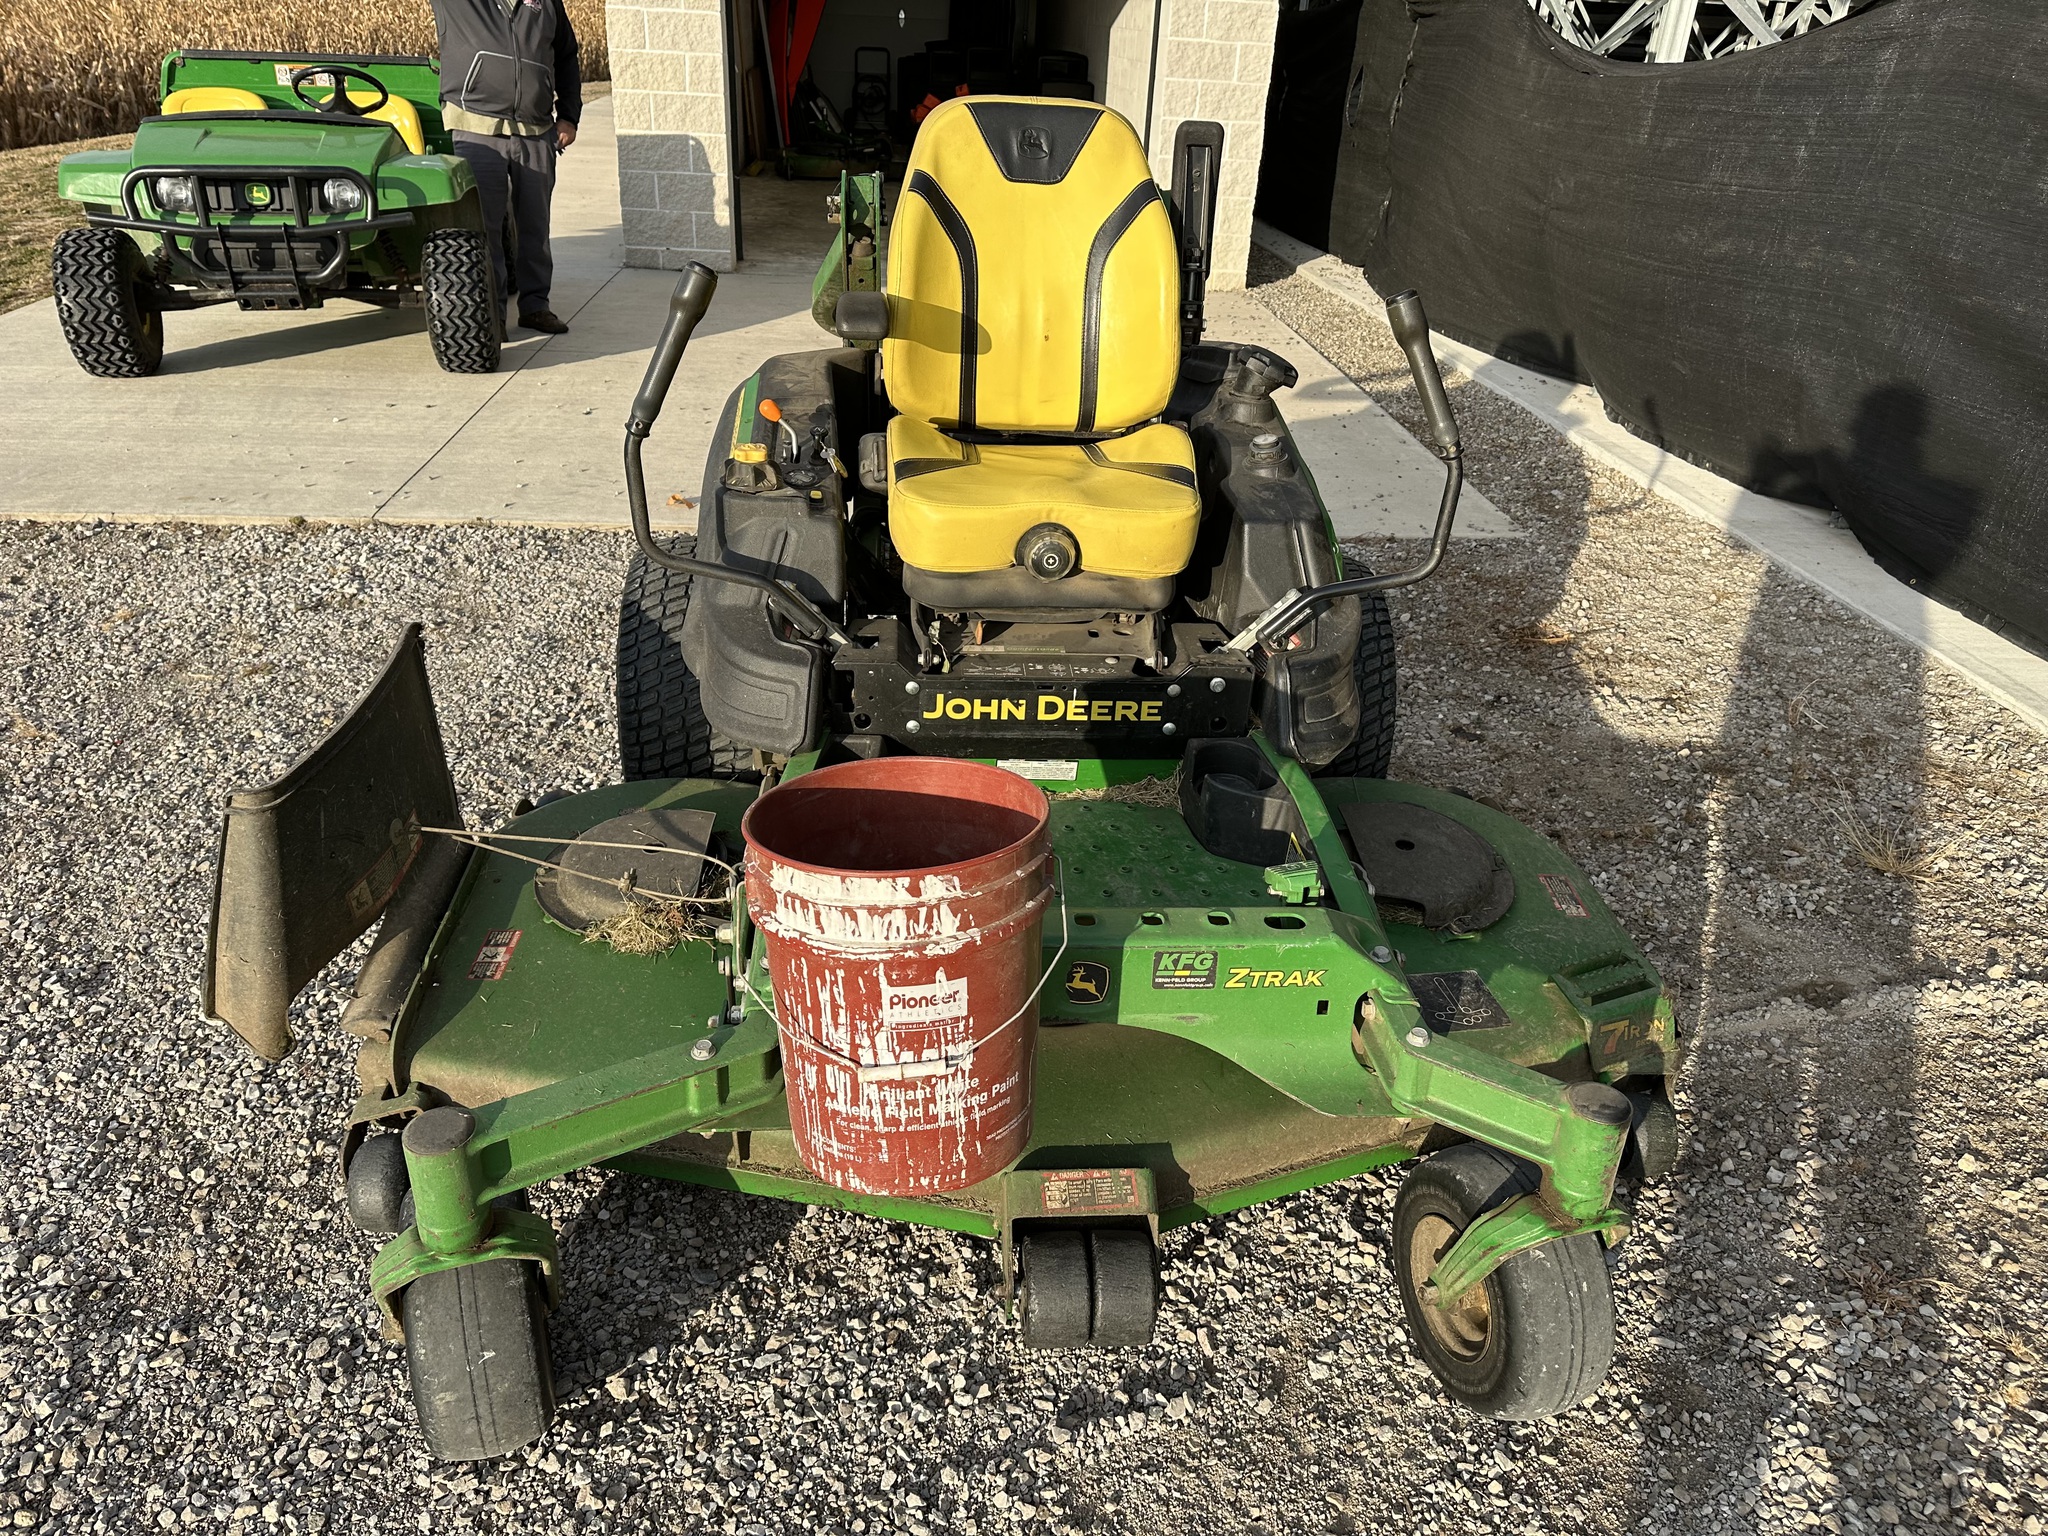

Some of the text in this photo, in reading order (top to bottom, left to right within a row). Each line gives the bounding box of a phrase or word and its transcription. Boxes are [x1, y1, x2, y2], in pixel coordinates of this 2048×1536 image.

[922, 693, 1163, 722] JOHN DEERE
[1158, 953, 1214, 970] KFG
[1223, 967, 1329, 989] ZTRAK
[889, 989, 960, 1010] Pioneer
[890, 1003, 962, 1018] ATHLETICS
[991, 1070, 1020, 1098] Paint
[906, 1119, 938, 1132] efficient
[970, 1106, 987, 1121] fild
